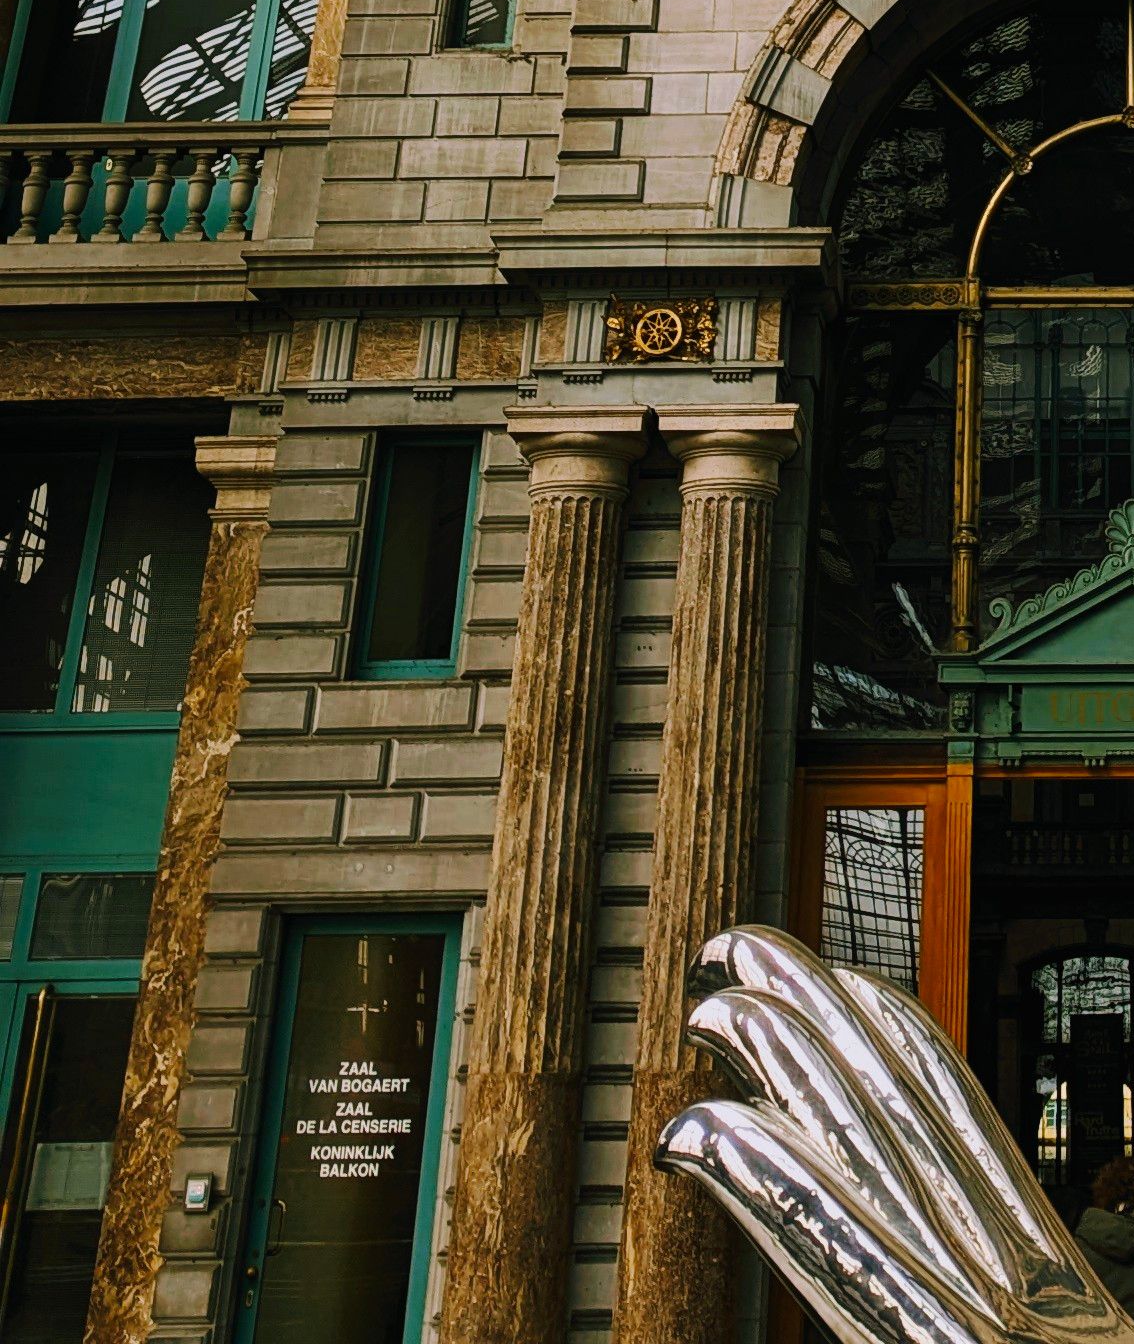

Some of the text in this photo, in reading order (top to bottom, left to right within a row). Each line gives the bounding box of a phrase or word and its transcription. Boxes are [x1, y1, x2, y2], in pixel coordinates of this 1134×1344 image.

[339, 1061, 378, 1076] ZAAL
[309, 1078, 410, 1093] VAN BOGAERT
[336, 1102, 373, 1116] ZAAL
[296, 1119, 412, 1134] DE LA CENSERIE
[310, 1145, 395, 1160] KONINKLIJK
[320, 1163, 380, 1177] BALKON
